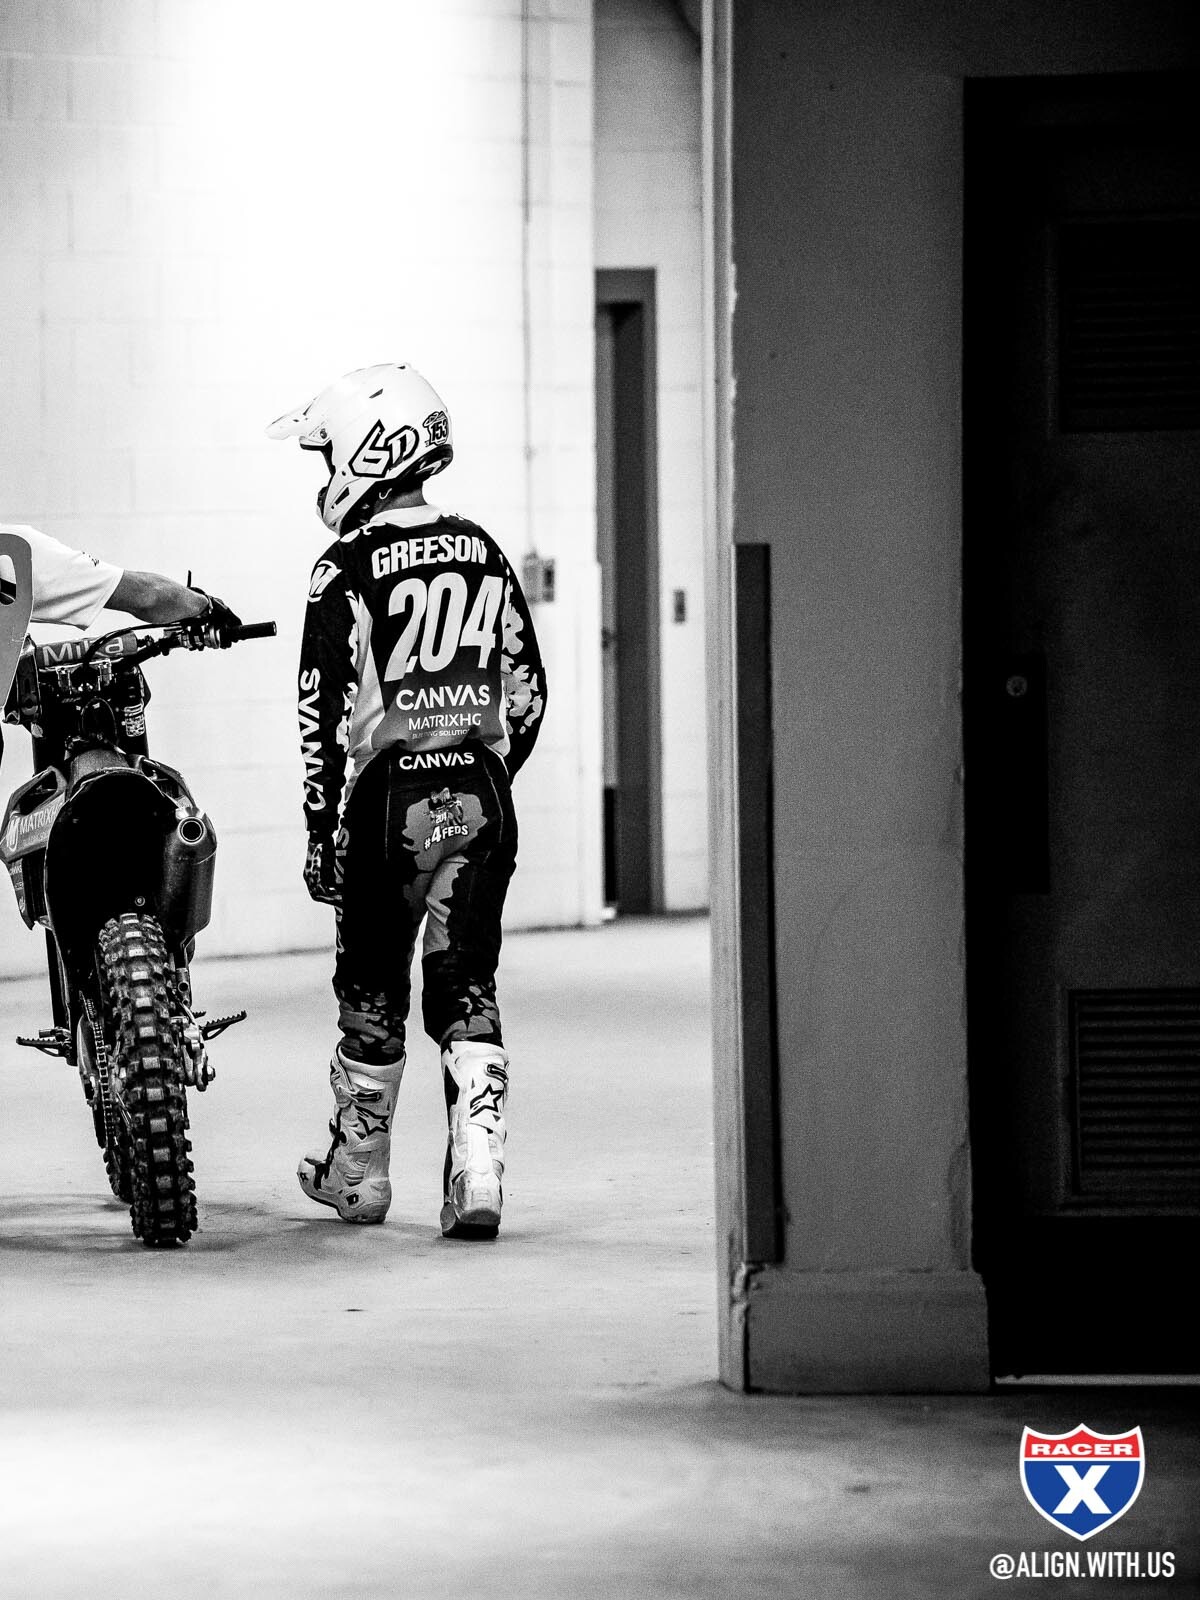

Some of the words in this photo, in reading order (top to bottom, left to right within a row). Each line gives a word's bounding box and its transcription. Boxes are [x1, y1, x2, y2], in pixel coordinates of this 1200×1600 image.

[371, 534, 488, 580] GREESON
[384, 571, 504, 683] 204
[395, 684, 491, 711] CANVAS
[297, 667, 327, 812] CANVAS
[408, 712, 482, 731] MATRIXHG
[398, 752, 475, 770] CANVAS
